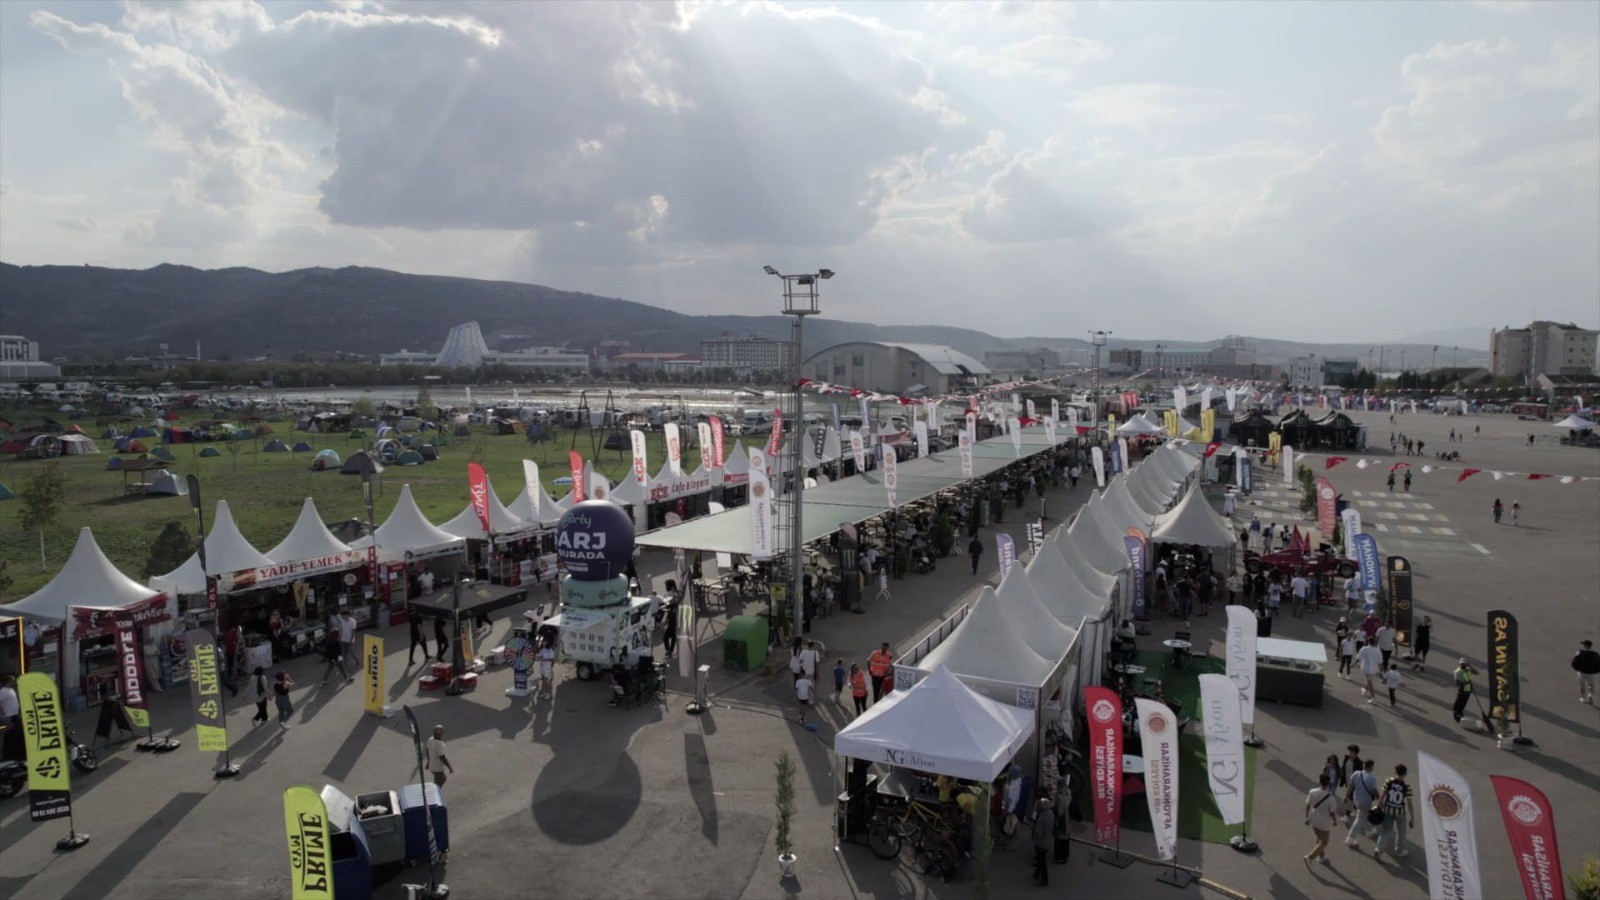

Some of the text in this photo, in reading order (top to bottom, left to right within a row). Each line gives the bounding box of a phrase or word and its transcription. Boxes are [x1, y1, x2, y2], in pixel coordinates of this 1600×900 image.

[557, 531, 606, 550] ARJ
[260, 563, 298, 578] YADE
[301, 554, 343, 570] YEMEK
[886, 750, 935, 768] NG Afyon
[1388, 789, 1403, 804] 10
